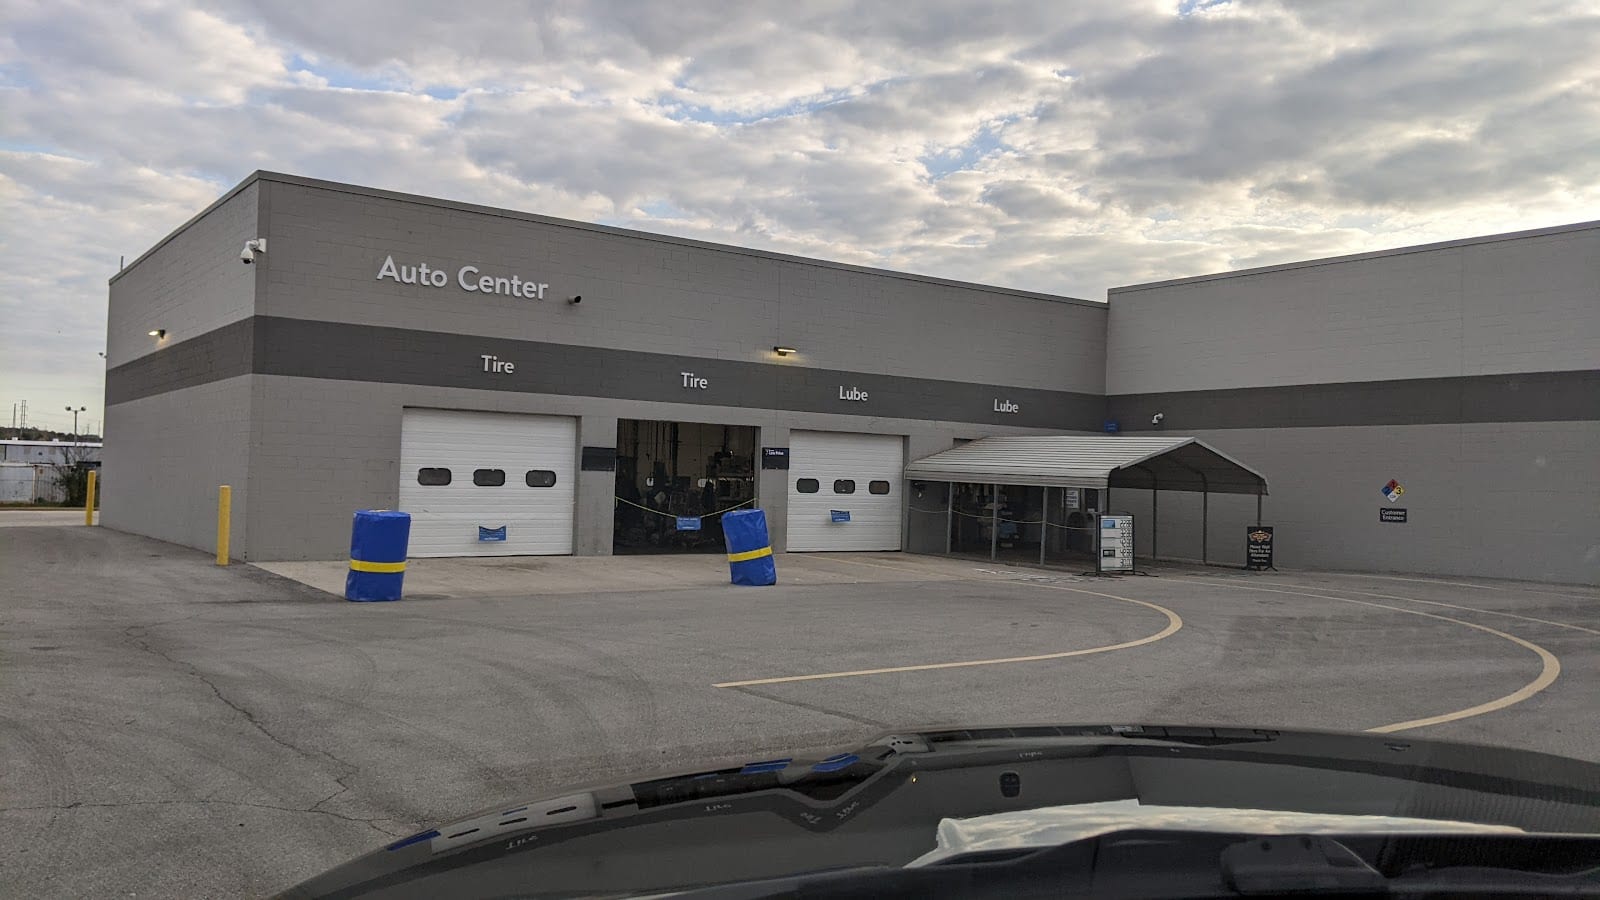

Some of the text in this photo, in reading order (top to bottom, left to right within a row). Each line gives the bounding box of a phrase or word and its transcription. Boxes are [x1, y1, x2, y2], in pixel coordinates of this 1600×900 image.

[376, 255, 549, 300] Auto Center
[481, 354, 515, 374] Tire
[680, 372, 708, 390] Tire
[839, 385, 869, 402] Lube
[993, 398, 1019, 414] Lube
